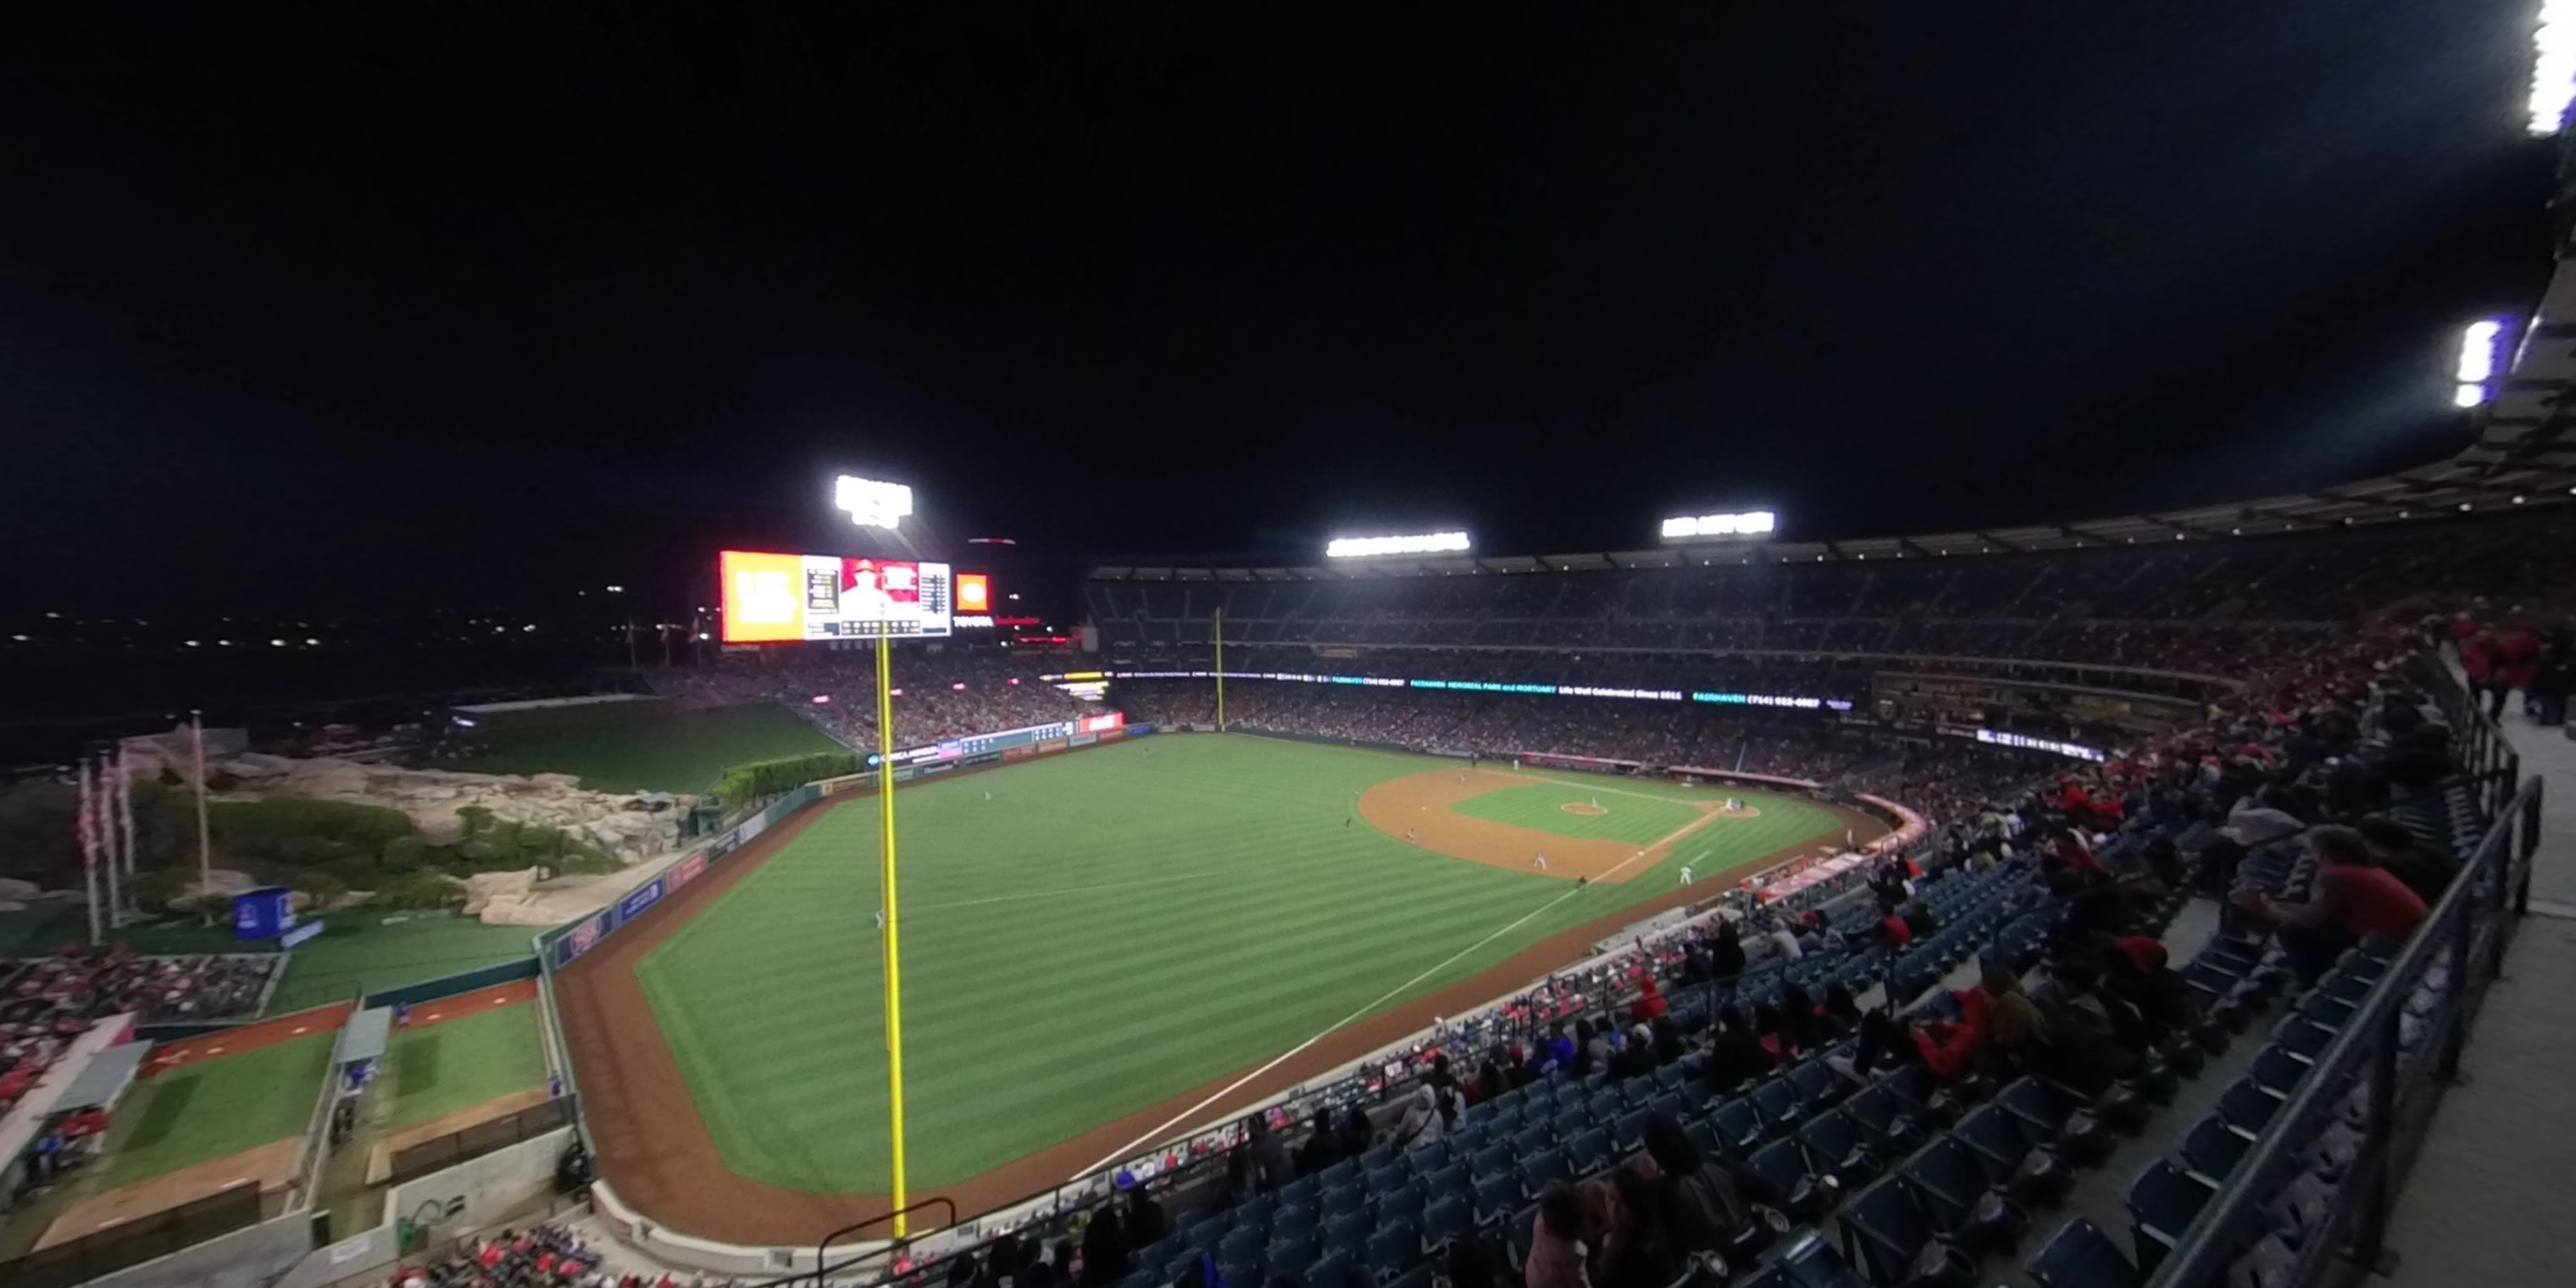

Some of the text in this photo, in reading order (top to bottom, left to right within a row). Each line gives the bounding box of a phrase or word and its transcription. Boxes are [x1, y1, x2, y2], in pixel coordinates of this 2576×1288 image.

[1410, 680, 1446, 688] FAIRHAVEN
[1447, 681, 1482, 690] MEMORIAL
[1483, 682, 1502, 691] PARK
[1502, 683, 1515, 691] and
[1516, 684, 1557, 693] MORTUARY
[1558, 686, 1574, 695] Life
[1574, 686, 1591, 696] Well
[1592, 687, 1635, 697] Celebrated
[1635, 690, 1658, 699] Since
[1693, 691, 1746, 703] FAIRHAVEN
[1747, 694, 1774, 705] (714)
